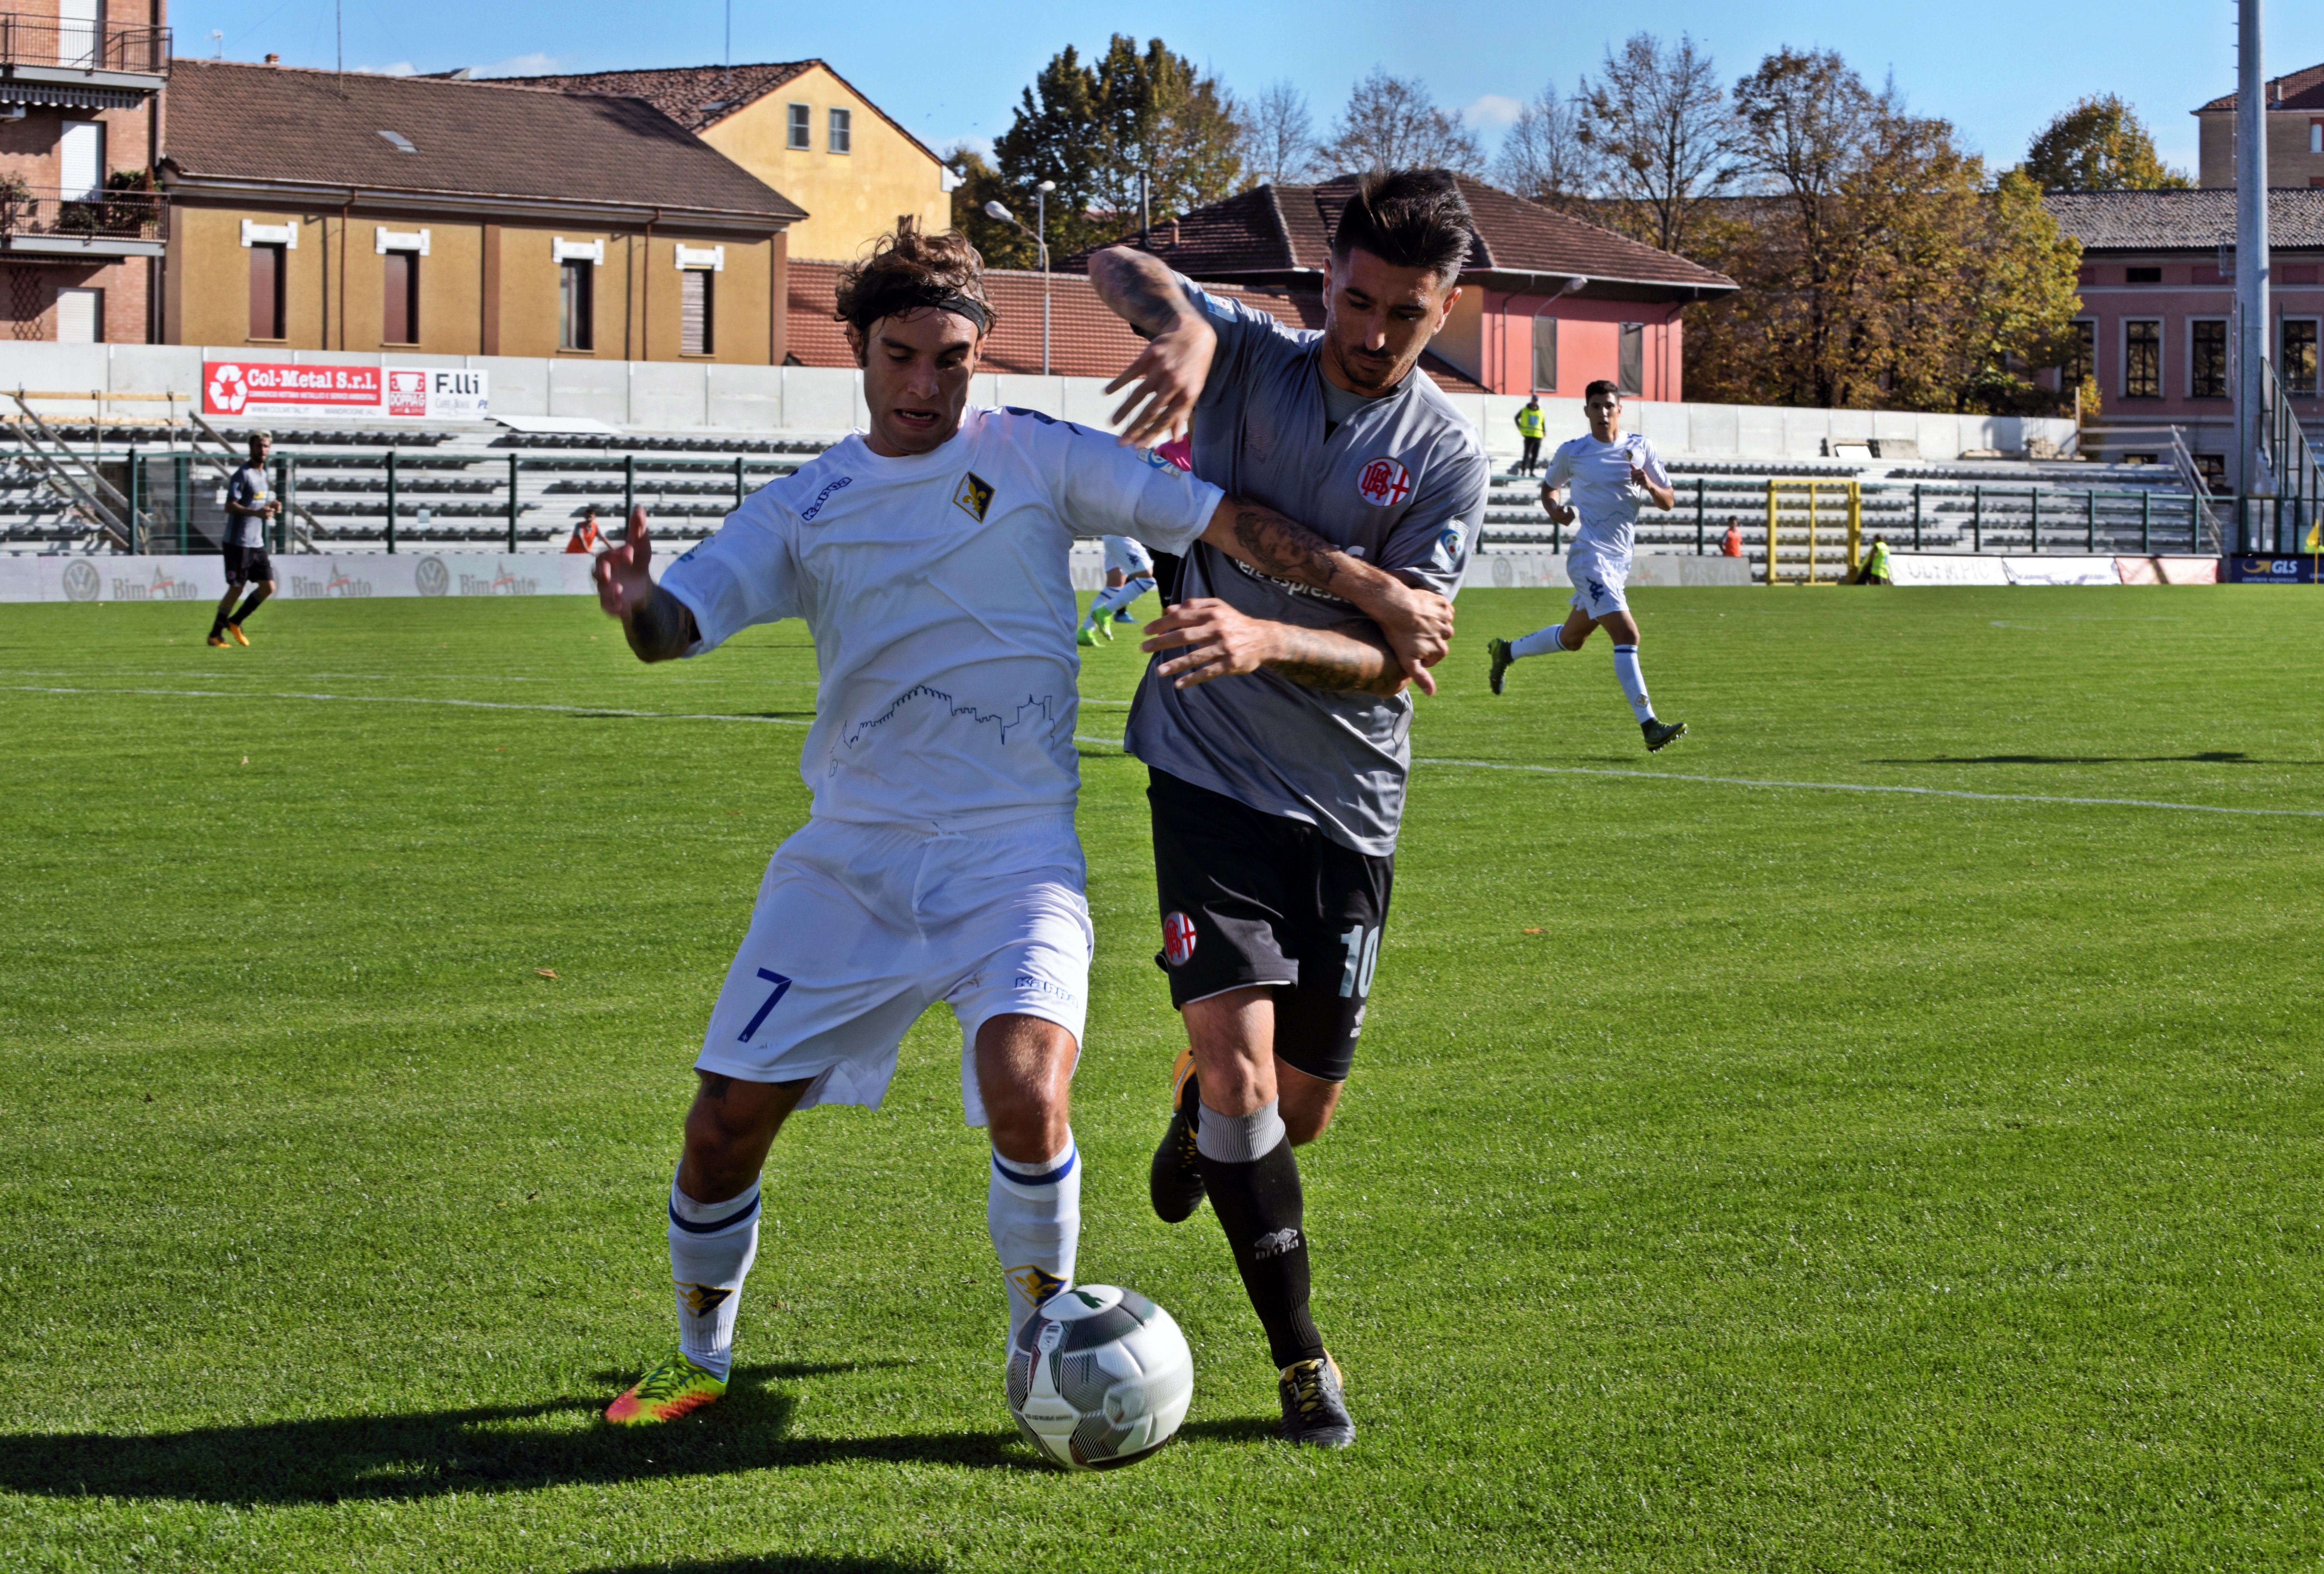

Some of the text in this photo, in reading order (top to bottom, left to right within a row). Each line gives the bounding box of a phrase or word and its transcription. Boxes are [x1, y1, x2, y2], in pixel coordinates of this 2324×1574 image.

[248, 368, 377, 390] Col-Metal S.r.l.
[436, 374, 478, 394] F.lli
[802, 477, 853, 521] Kappa
[1907, 558, 1990, 580] OLYMPIC
[2271, 560, 2298, 574] GLS
[1338, 925, 1379, 998] 10
[737, 967, 793, 1043] 7
